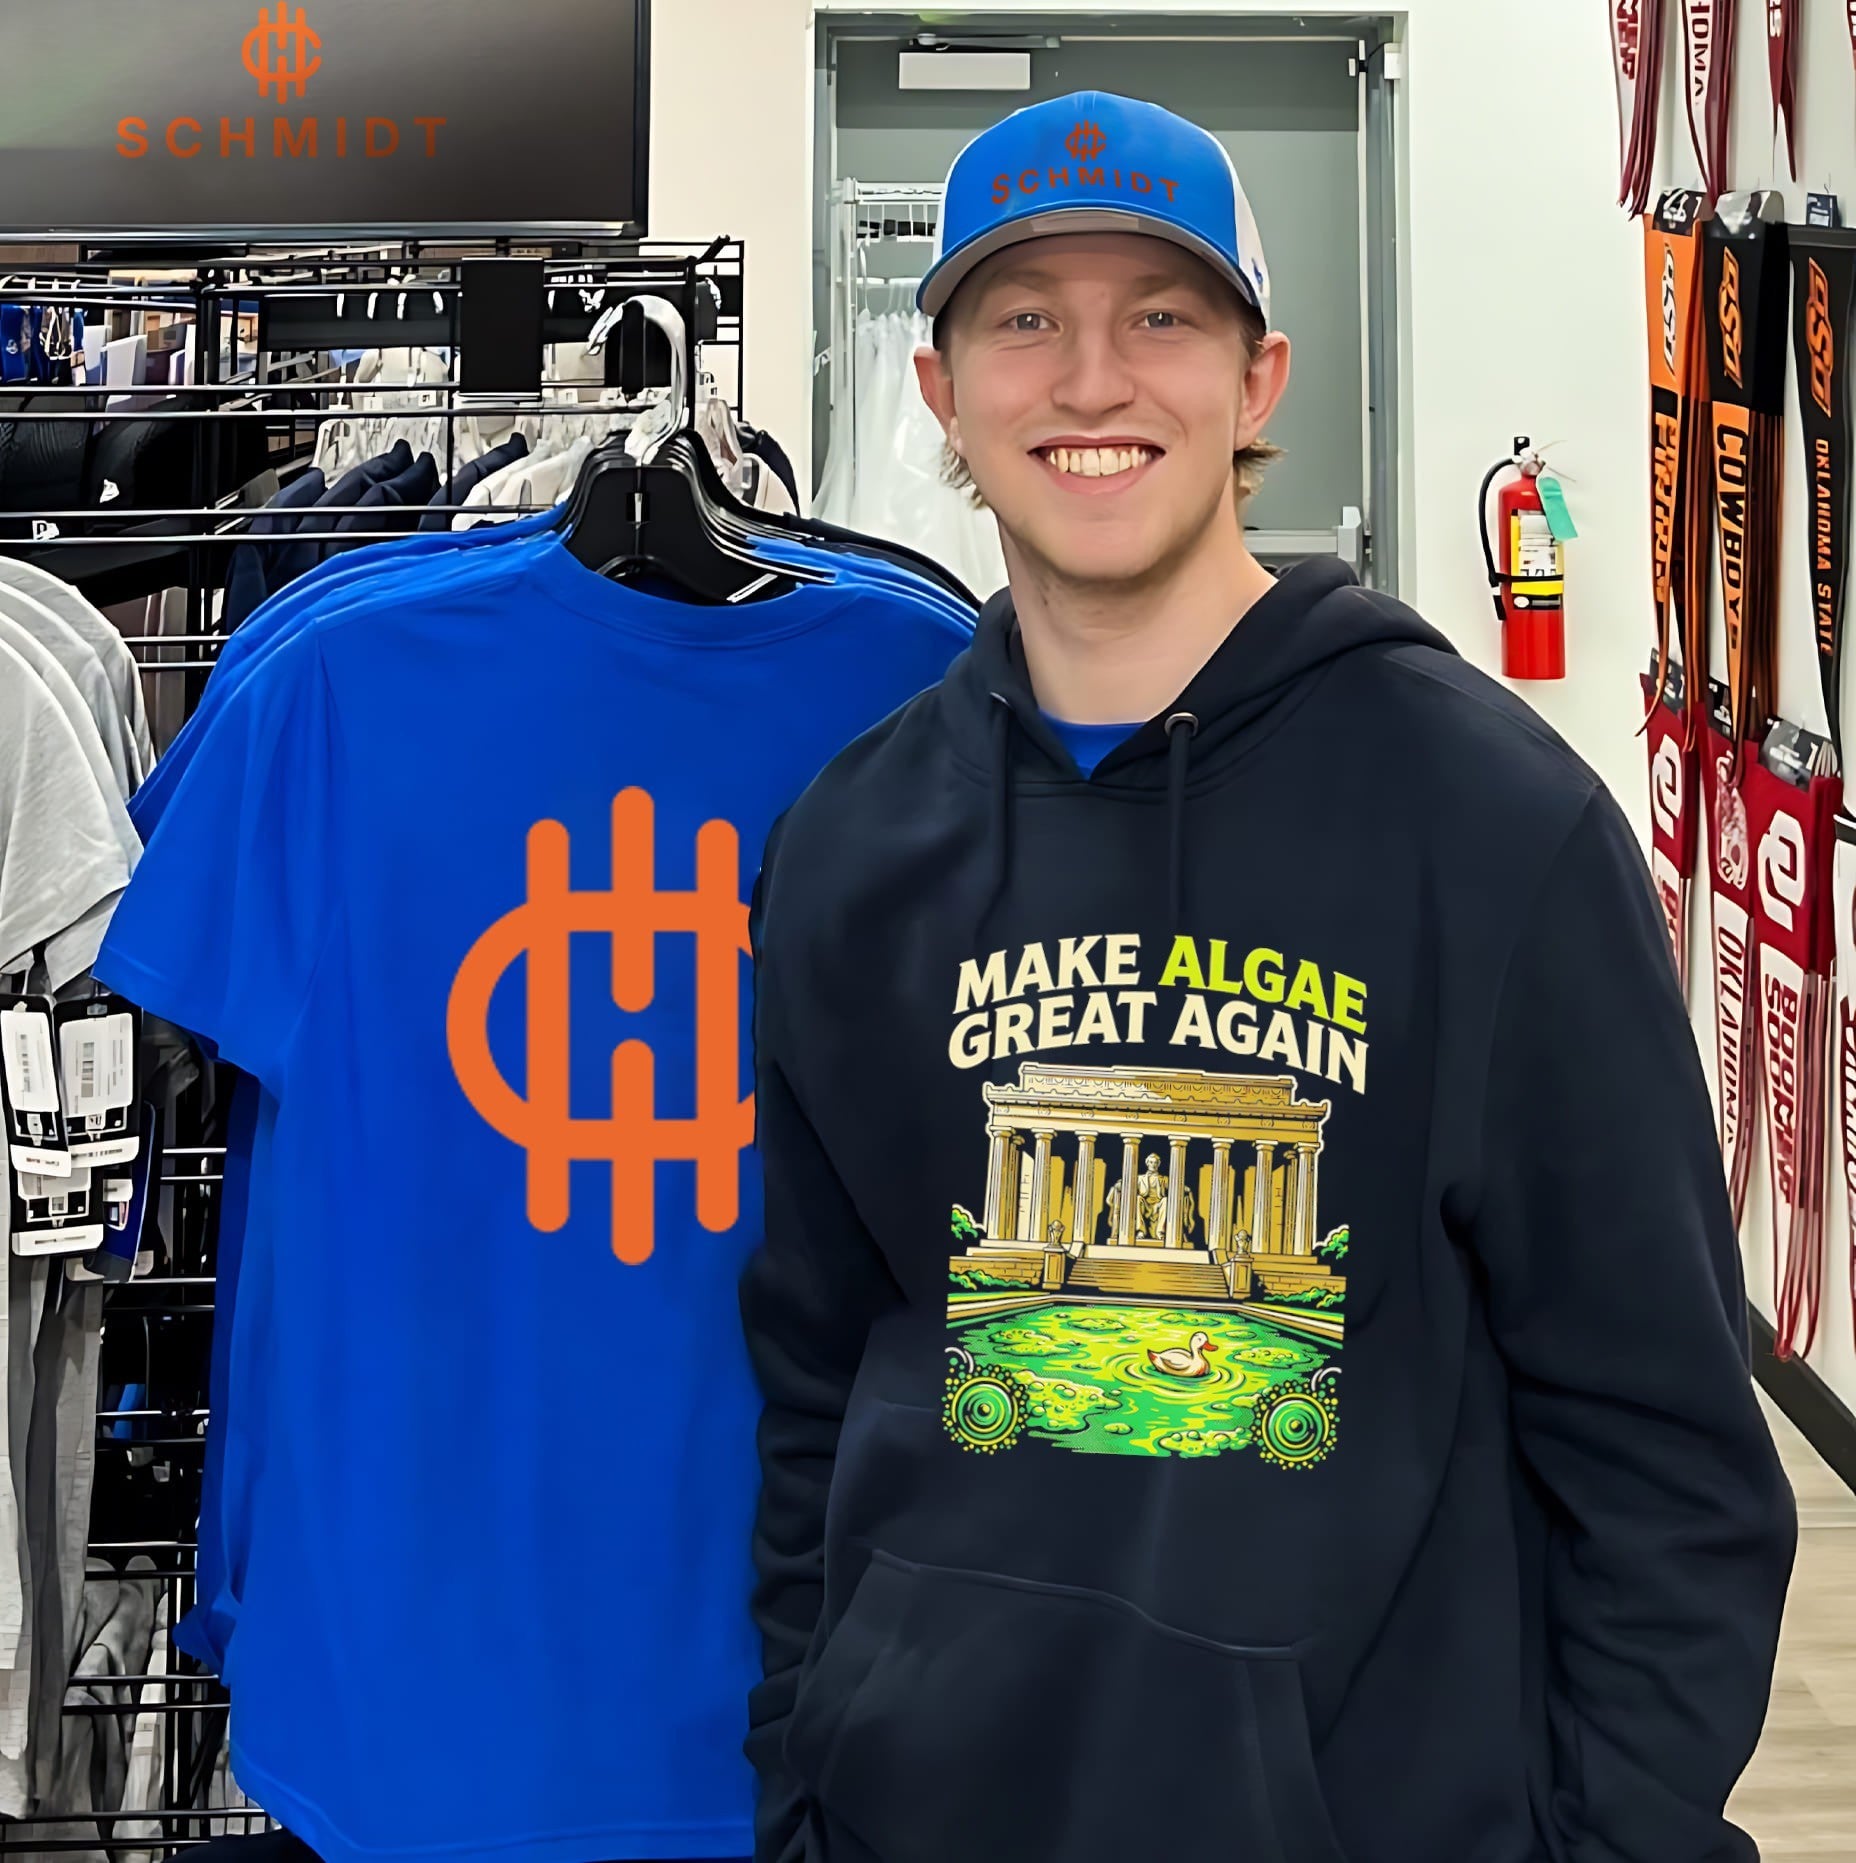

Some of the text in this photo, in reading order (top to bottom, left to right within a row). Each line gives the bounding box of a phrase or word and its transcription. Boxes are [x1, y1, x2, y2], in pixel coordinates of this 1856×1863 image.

[116, 117, 447, 158] SCHMIDT
[991, 167, 1179, 204] SCHMIDT
[952, 933, 1368, 1034] MAKE ALGAE
[948, 991, 1369, 1095] GREAT AGAIN
